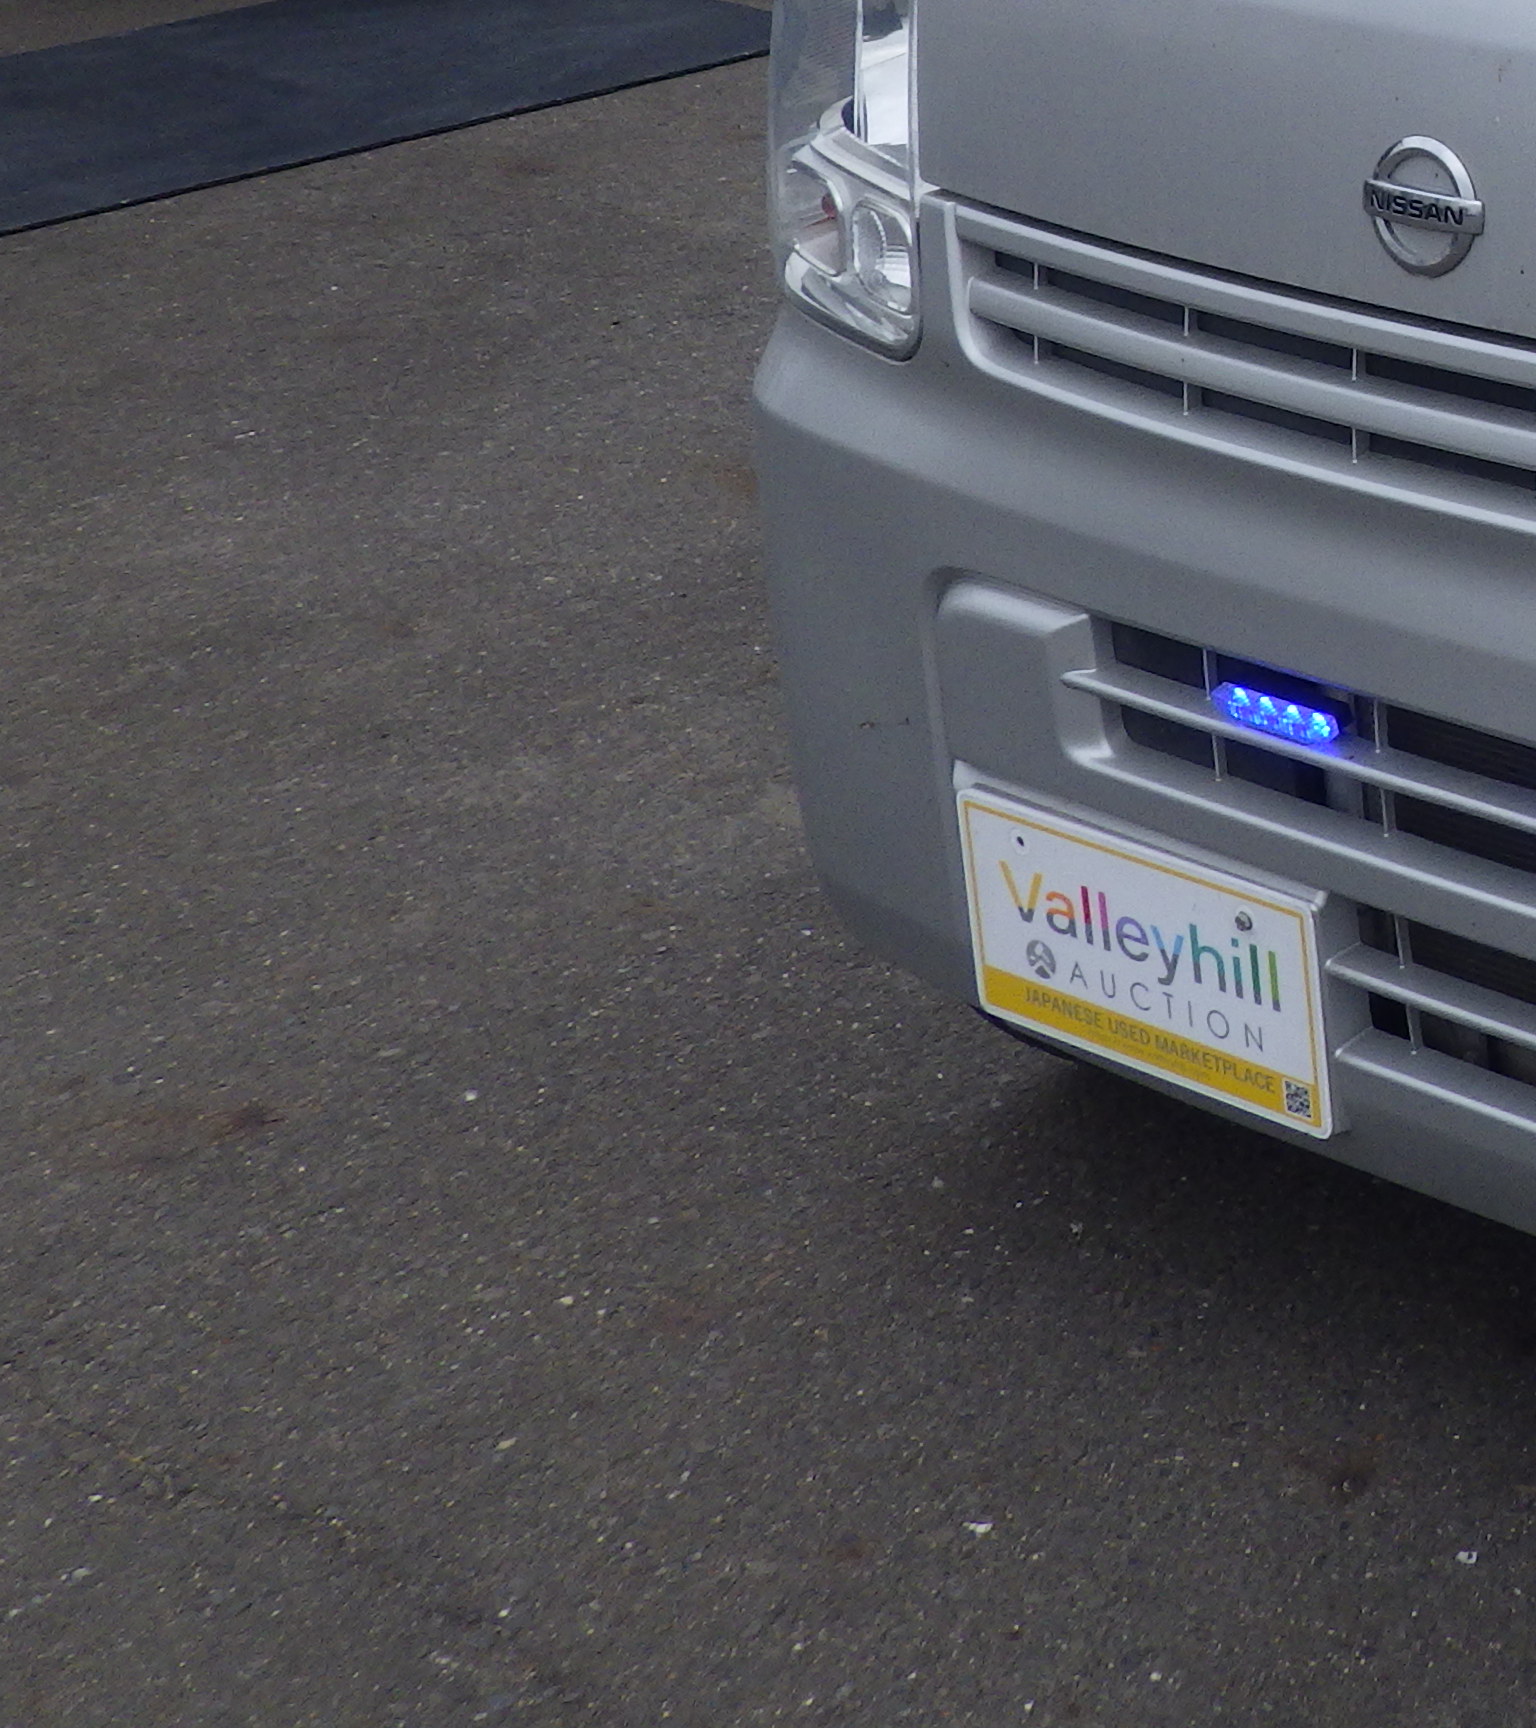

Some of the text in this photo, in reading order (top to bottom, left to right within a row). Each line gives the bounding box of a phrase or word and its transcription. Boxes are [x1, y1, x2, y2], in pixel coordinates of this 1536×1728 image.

[1370, 189, 1464, 226] NISSAN
[999, 859, 1281, 1013] Valleyhill
[1024, 986, 1104, 1030] JAPANESE
[1107, 1016, 1151, 1047] USED
[1155, 1033, 1276, 1095] MARKETPLACE
[1069, 961, 1264, 1053] AUCTION
